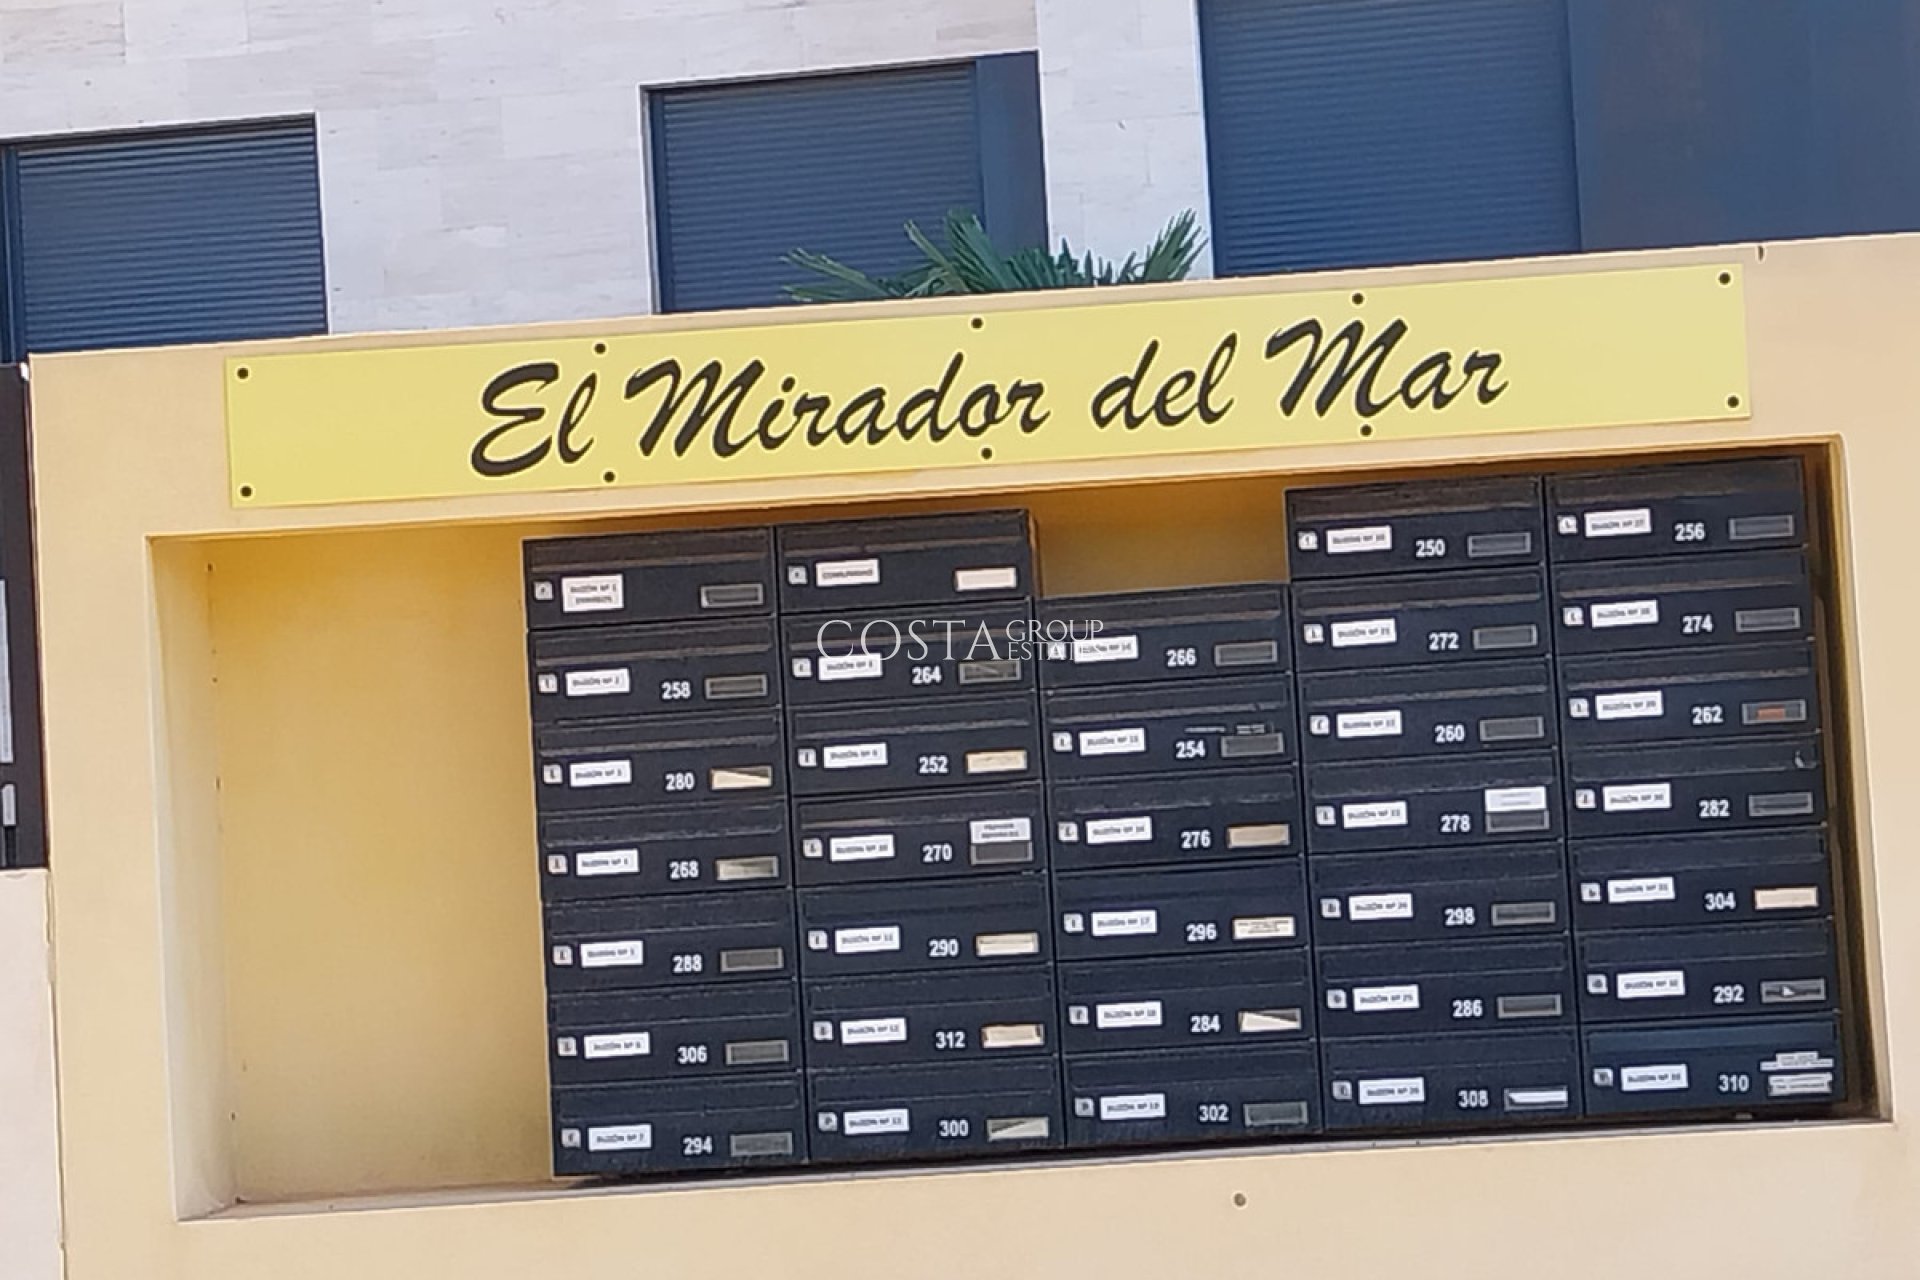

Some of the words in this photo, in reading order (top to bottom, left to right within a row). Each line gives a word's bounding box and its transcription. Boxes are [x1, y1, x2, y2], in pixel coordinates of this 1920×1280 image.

[471, 362, 598, 477] El
[624, 352, 1050, 457] Mirador
[1091, 332, 1238, 430] del
[1265, 317, 1508, 417] Mar
[1674, 522, 1705, 542] 256
[1415, 538, 1446, 558] 250
[1682, 614, 1713, 633] 274
[1429, 631, 1459, 651] 272
[1166, 647, 1197, 667] 266
[911, 665, 942, 685] 264
[661, 681, 691, 700] 258
[1692, 705, 1723, 725] 262
[1434, 724, 1465, 743] 260
[1175, 740, 1206, 759] 254
[919, 755, 949, 774] 252
[665, 772, 695, 791] 280
[1699, 799, 1730, 818] 282
[1441, 814, 1471, 833] 278
[1181, 829, 1211, 849] 276
[922, 843, 953, 863] 270
[669, 860, 699, 879] 268
[1705, 891, 1736, 911] 304
[1445, 906, 1476, 926] 298
[1186, 923, 1217, 942] 296
[929, 938, 959, 957] 290
[673, 953, 703, 973] 288
[1713, 984, 1745, 1004] 292
[1452, 999, 1483, 1017] 286
[1191, 1015, 1221, 1033] 284
[935, 1031, 966, 1049] 312
[677, 1045, 708, 1065] 306
[1719, 1074, 1749, 1092] 310
[1458, 1089, 1489, 1108] 308
[1199, 1103, 1229, 1122] 302
[939, 1119, 969, 1137] 300
[683, 1135, 713, 1155] 294
